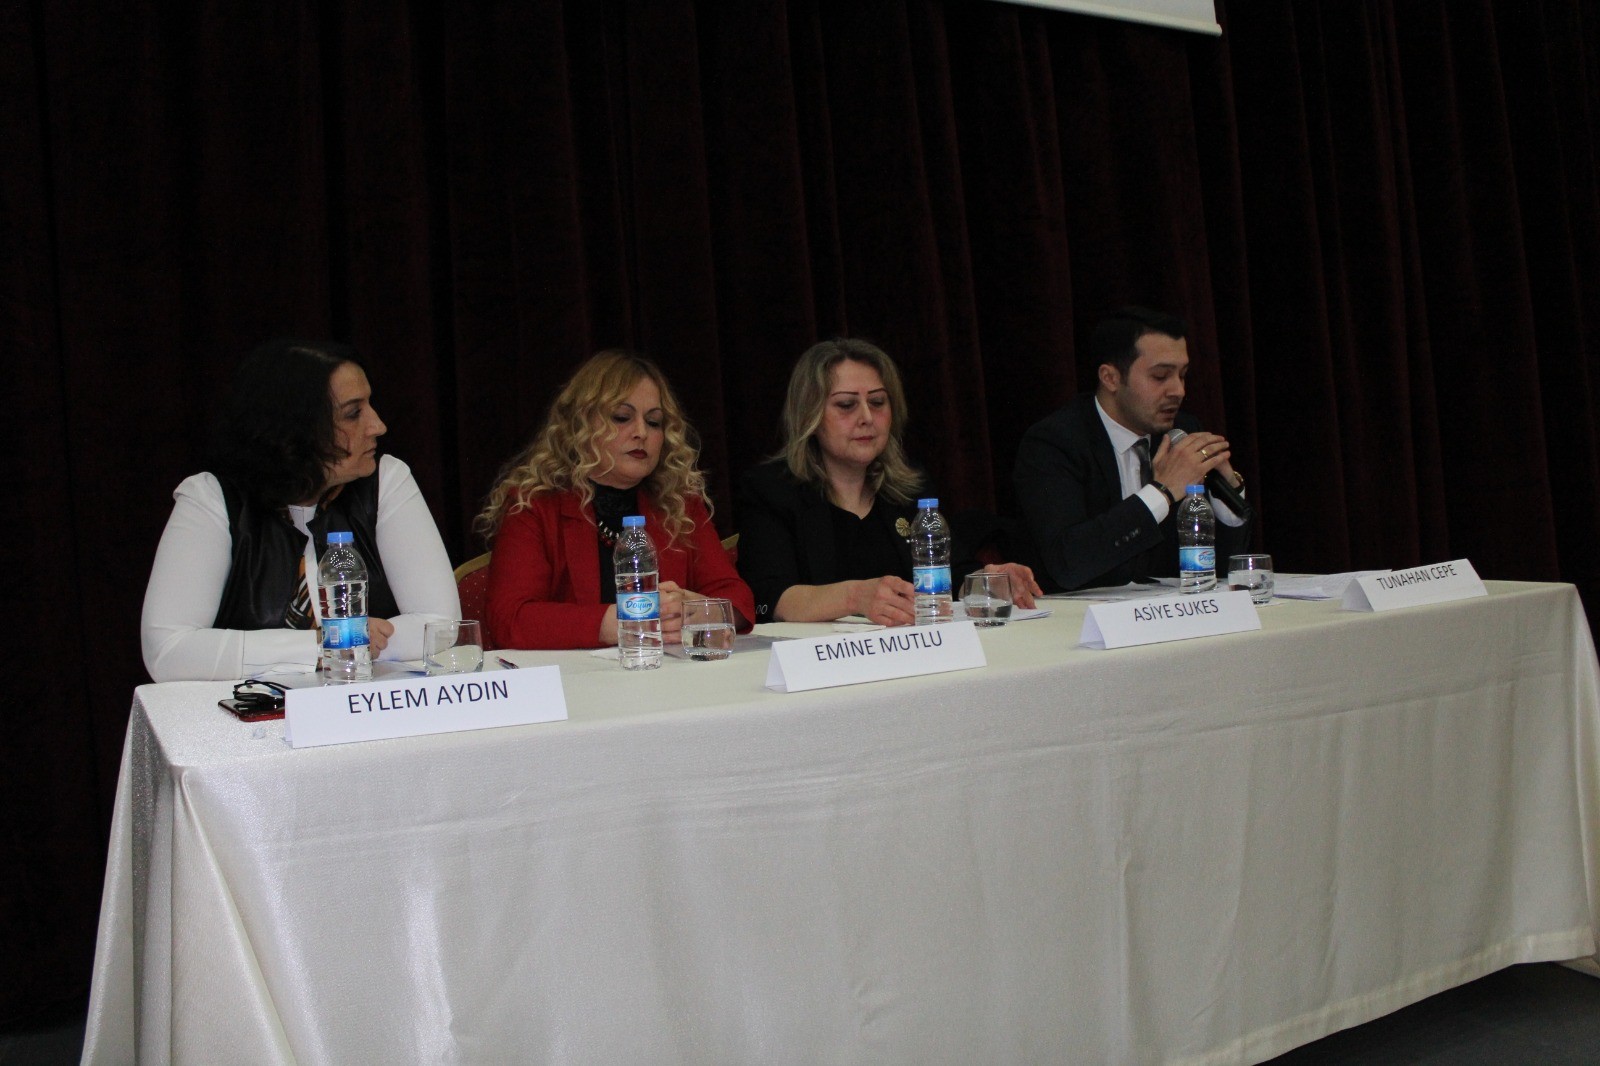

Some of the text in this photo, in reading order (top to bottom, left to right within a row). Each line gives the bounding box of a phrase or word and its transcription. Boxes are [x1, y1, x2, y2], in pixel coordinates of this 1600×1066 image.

[1376, 563, 1458, 590] TUNAHAN CEPE
[625, 600, 653, 611] Doyum
[1134, 599, 1219, 622] ASİYE SUKES
[814, 630, 943, 661] EMİNE MUTLU
[348, 680, 509, 714] EYLEM AYDIN
